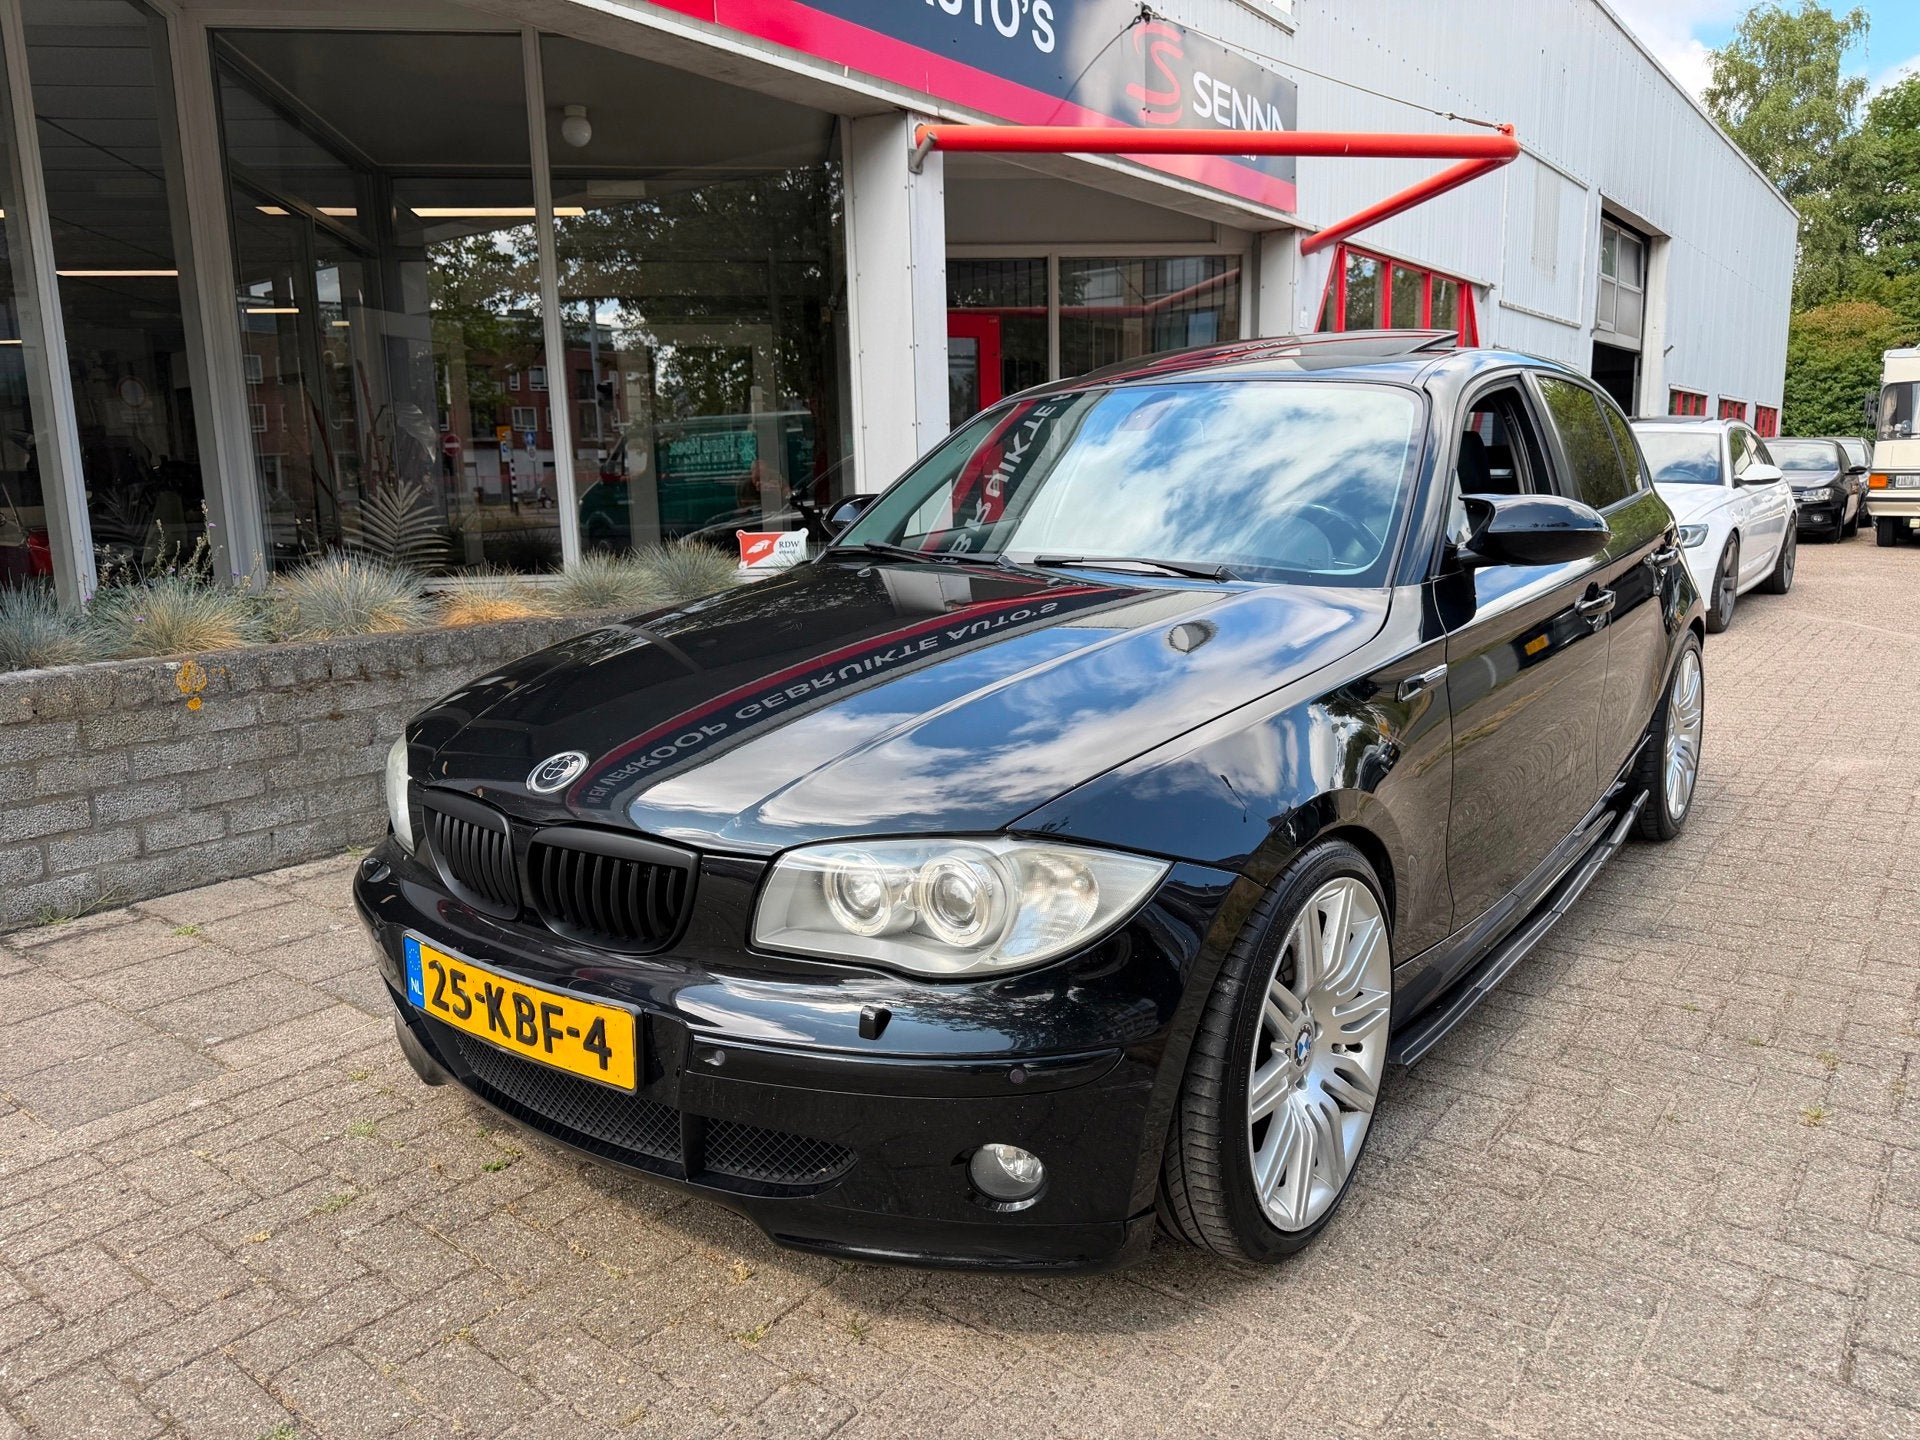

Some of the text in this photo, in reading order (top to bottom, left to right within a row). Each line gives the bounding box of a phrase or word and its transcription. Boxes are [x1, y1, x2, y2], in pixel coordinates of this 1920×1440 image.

[925, 0, 1055, 54] O'S
[1192, 71, 1285, 131] SENNA
[778, 540, 800, 549] RDW
[410, 976, 423, 997] NL
[428, 959, 613, 1071] 25-KBF-4
